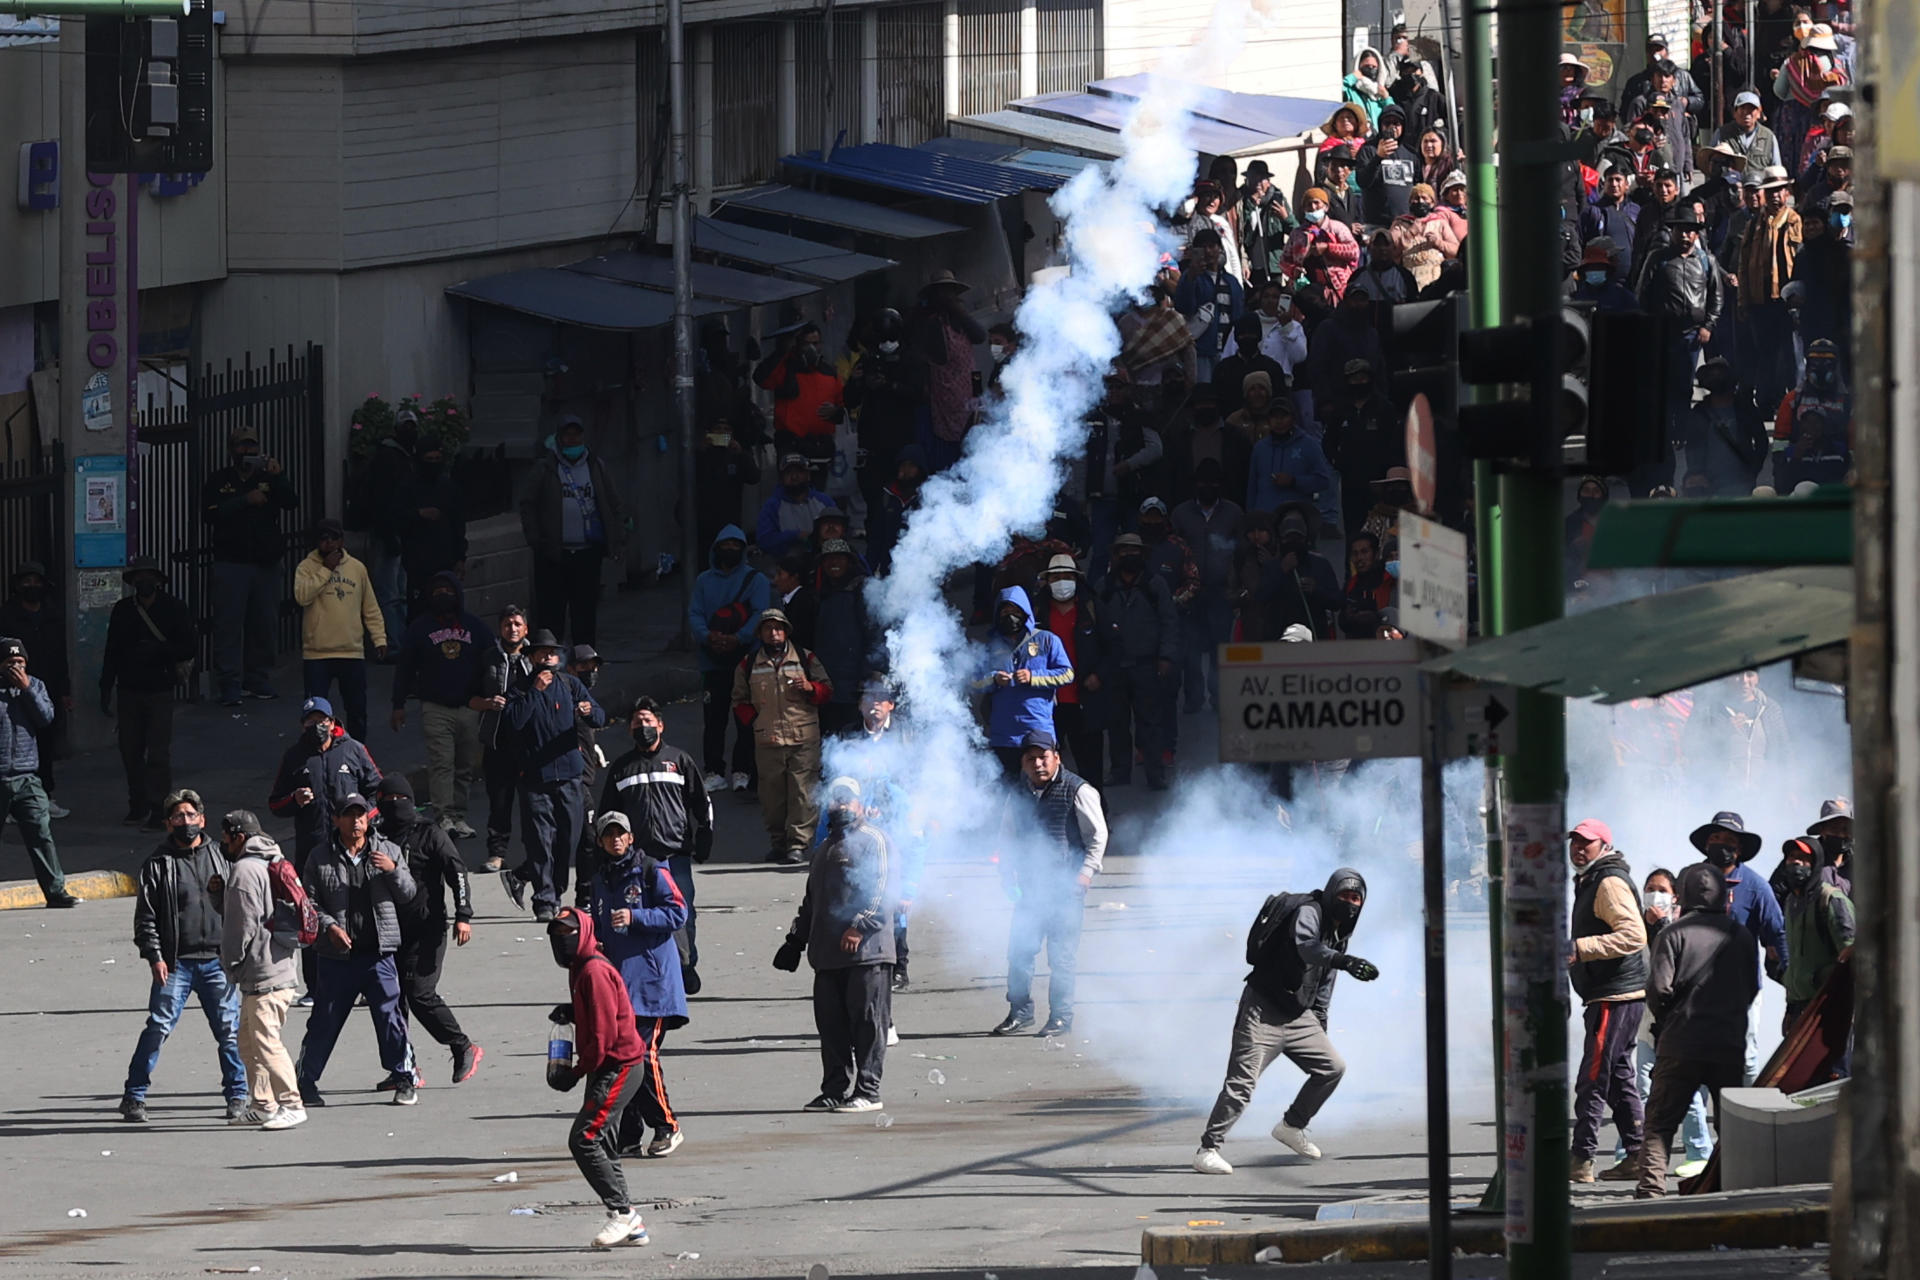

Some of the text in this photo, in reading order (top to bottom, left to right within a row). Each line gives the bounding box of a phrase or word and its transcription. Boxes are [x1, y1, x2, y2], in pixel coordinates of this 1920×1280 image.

[1240, 674, 1402, 696] AV. Eliodoro
[1243, 698, 1405, 730] CAMACHO
